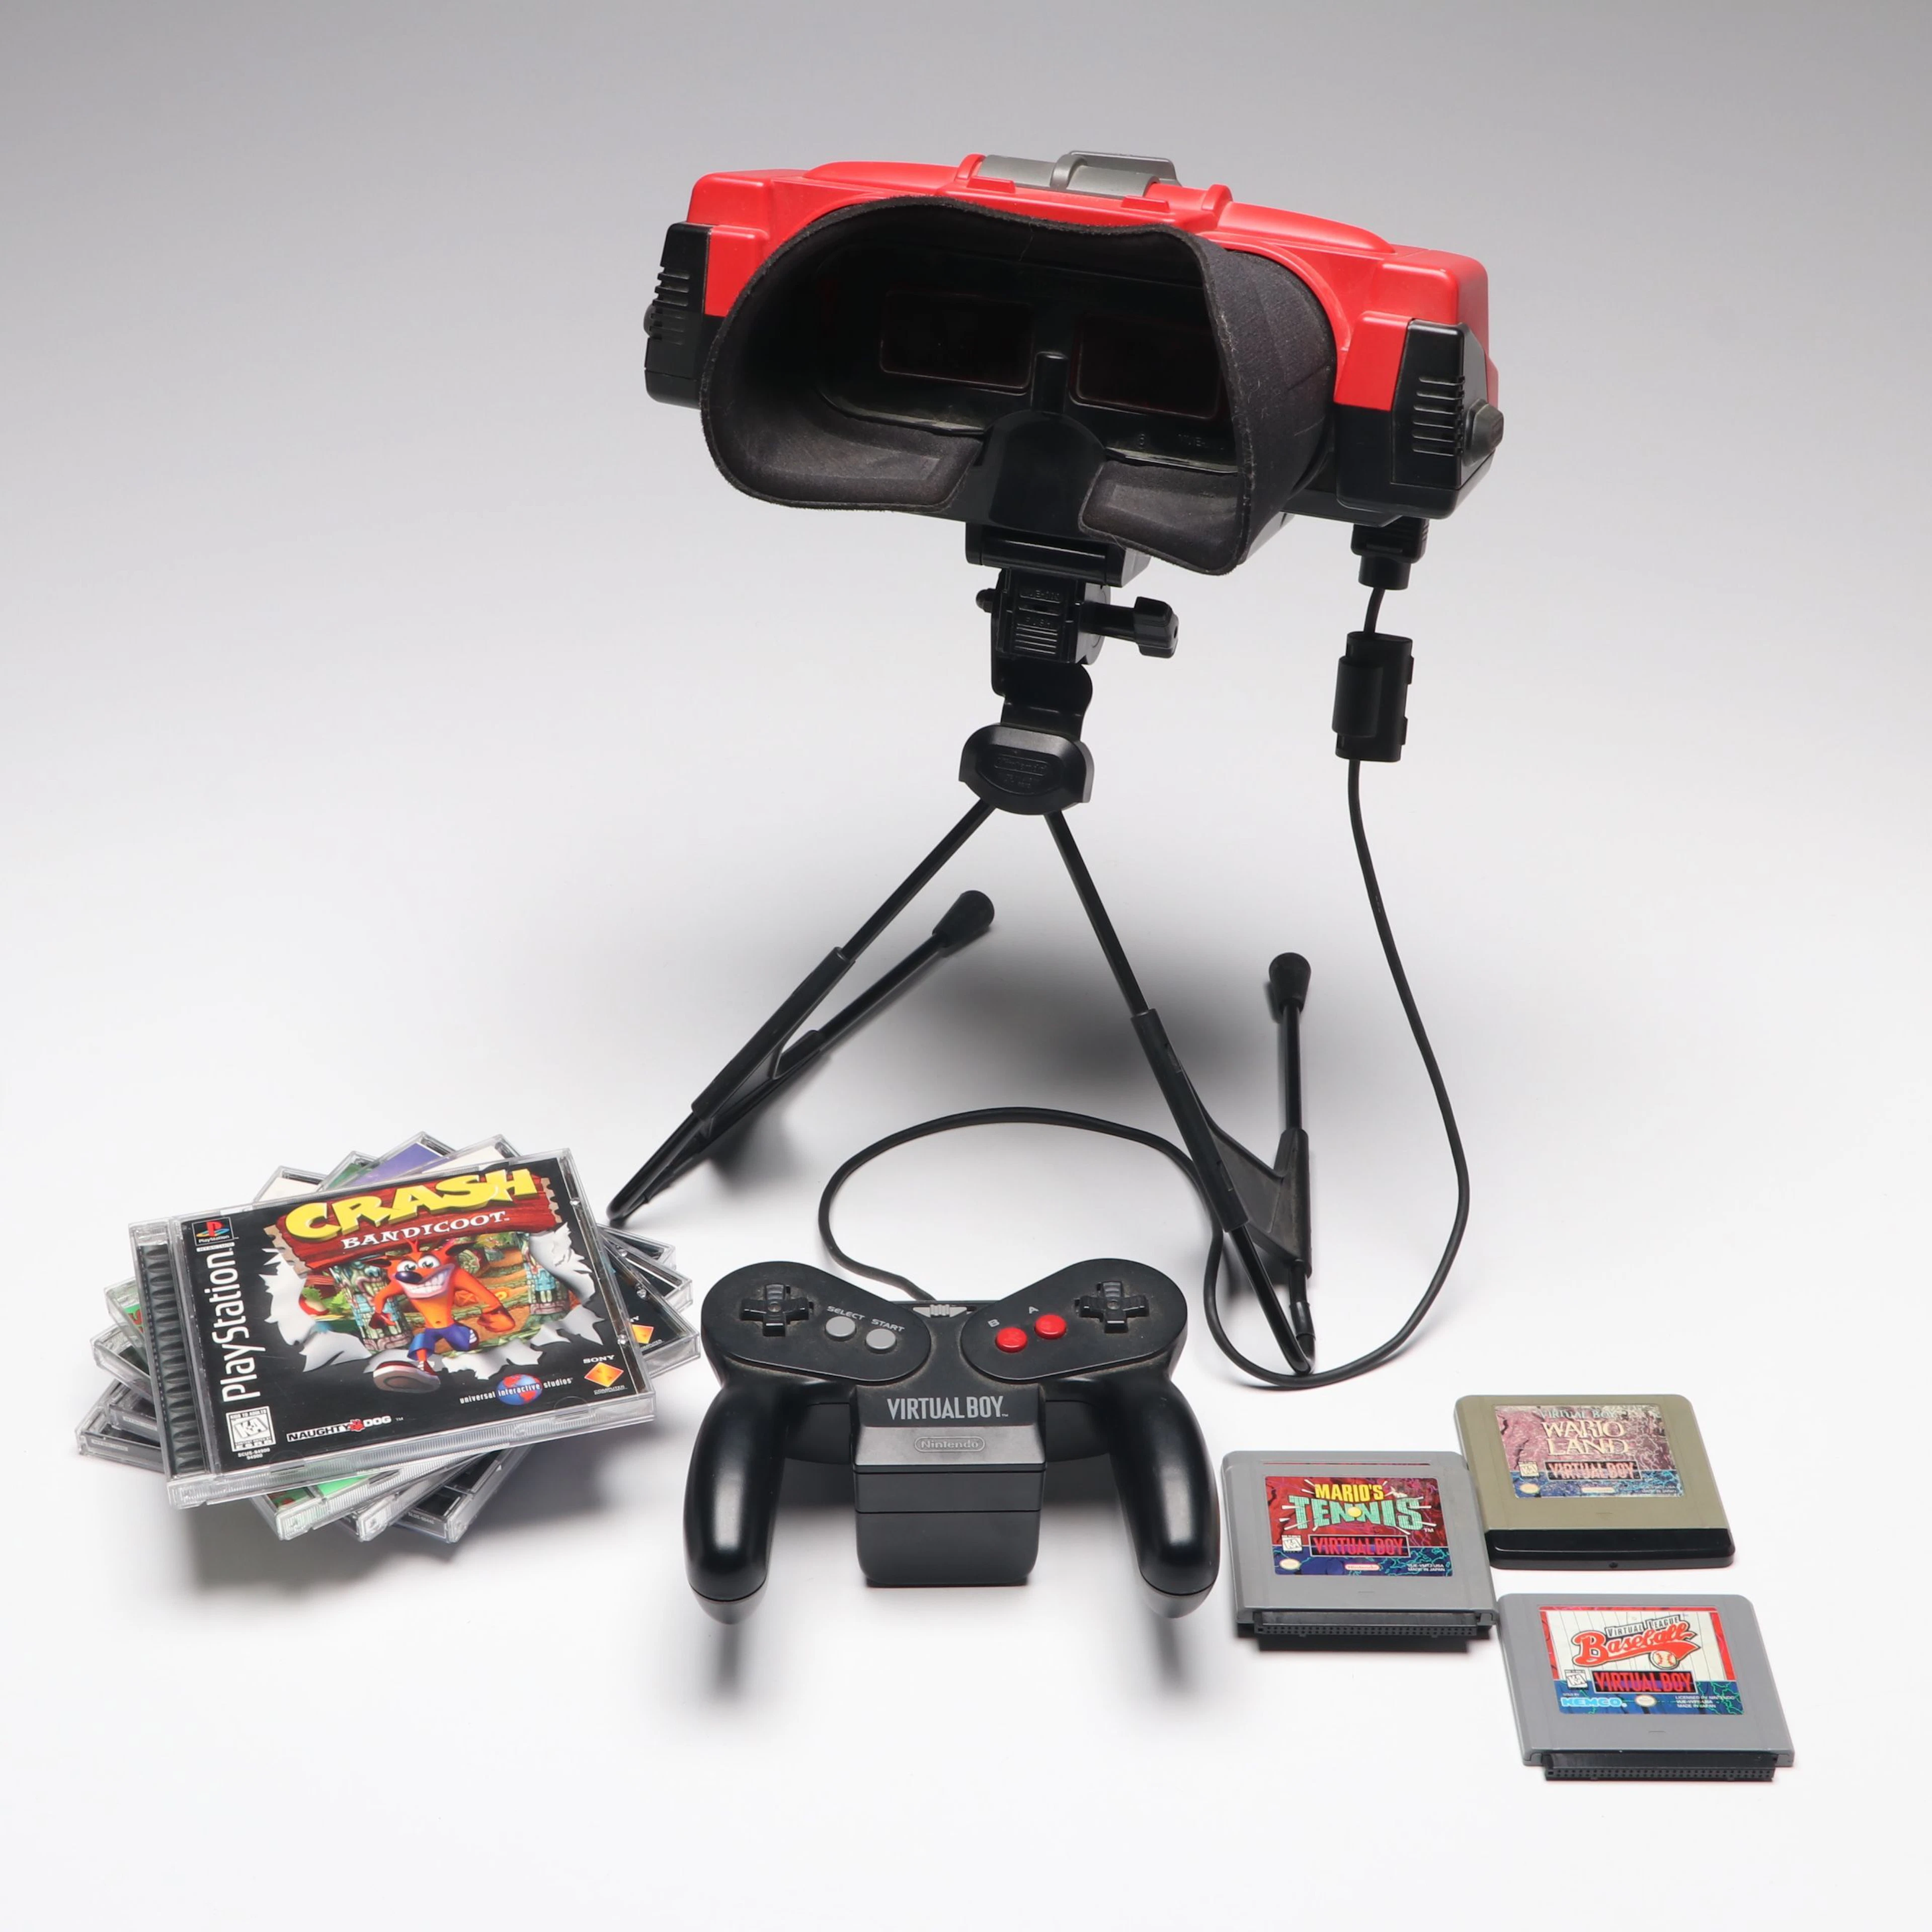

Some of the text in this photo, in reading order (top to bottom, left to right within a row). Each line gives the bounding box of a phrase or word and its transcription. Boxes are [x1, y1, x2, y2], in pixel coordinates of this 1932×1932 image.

[285, 1168, 538, 1240] CRASH
[198, 1235, 230, 1243] PlayStation
[341, 1211, 506, 1249] BANDICOOT
[204, 1251, 266, 1402] PlayStation
[827, 1306, 905, 1332] SELECT START
[988, 1319, 1000, 1327] B
[583, 1354, 615, 1364] SONY
[460, 1378, 572, 1404] universal interactive studios
[887, 1397, 965, 1420] VIRTUAL
[967, 1396, 1004, 1419] BOY
[1540, 1409, 1616, 1419] VIRTUAL BOY
[288, 1423, 350, 1441] NAUGHTY
[363, 1415, 392, 1427] DOG
[1541, 1419, 1625, 1438] WARIO
[920, 1440, 980, 1448] Nintendo
[1546, 1437, 1629, 1456] LAND
[1548, 1462, 1635, 1479] VIRTUAL BOY
[1314, 1484, 1384, 1502] MARIO'S
[1289, 1495, 1423, 1531] TENNIS
[1313, 1537, 1404, 1555] VIRTUAL BOY
[1607, 1617, 1679, 1637] VIRTUAL LEAGUE
[1572, 1621, 1696, 1666] Baseball
[1593, 1672, 1693, 1693] VIRTUAL BOY
[1561, 1697, 1623, 1707] KEMCO
